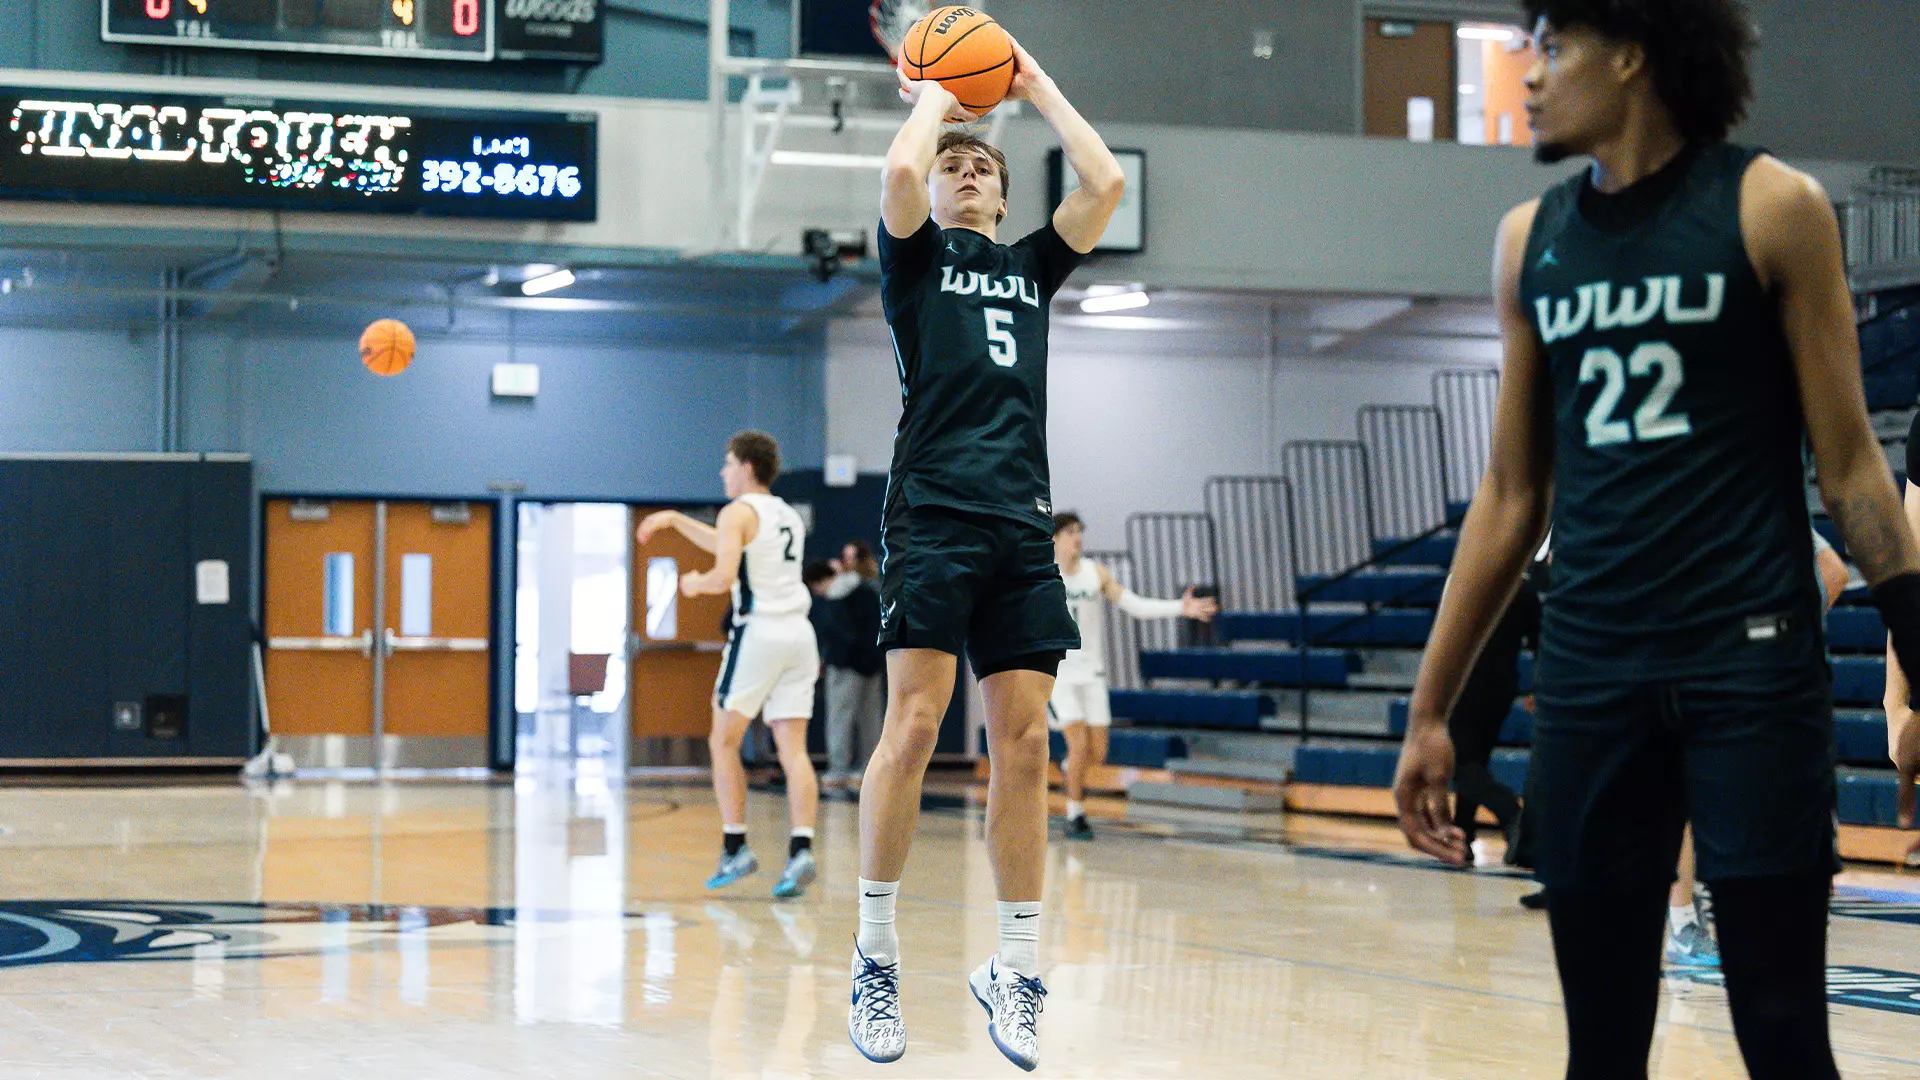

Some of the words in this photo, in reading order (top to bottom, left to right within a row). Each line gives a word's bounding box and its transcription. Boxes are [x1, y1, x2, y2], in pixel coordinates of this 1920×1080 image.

[422, 160, 582, 198] 392-8676
[941, 265, 1039, 308] WWU
[1535, 272, 1726, 345] WWU
[984, 307, 1017, 368] 5
[1579, 341, 1692, 447] 22
[780, 527, 796, 561] 2
